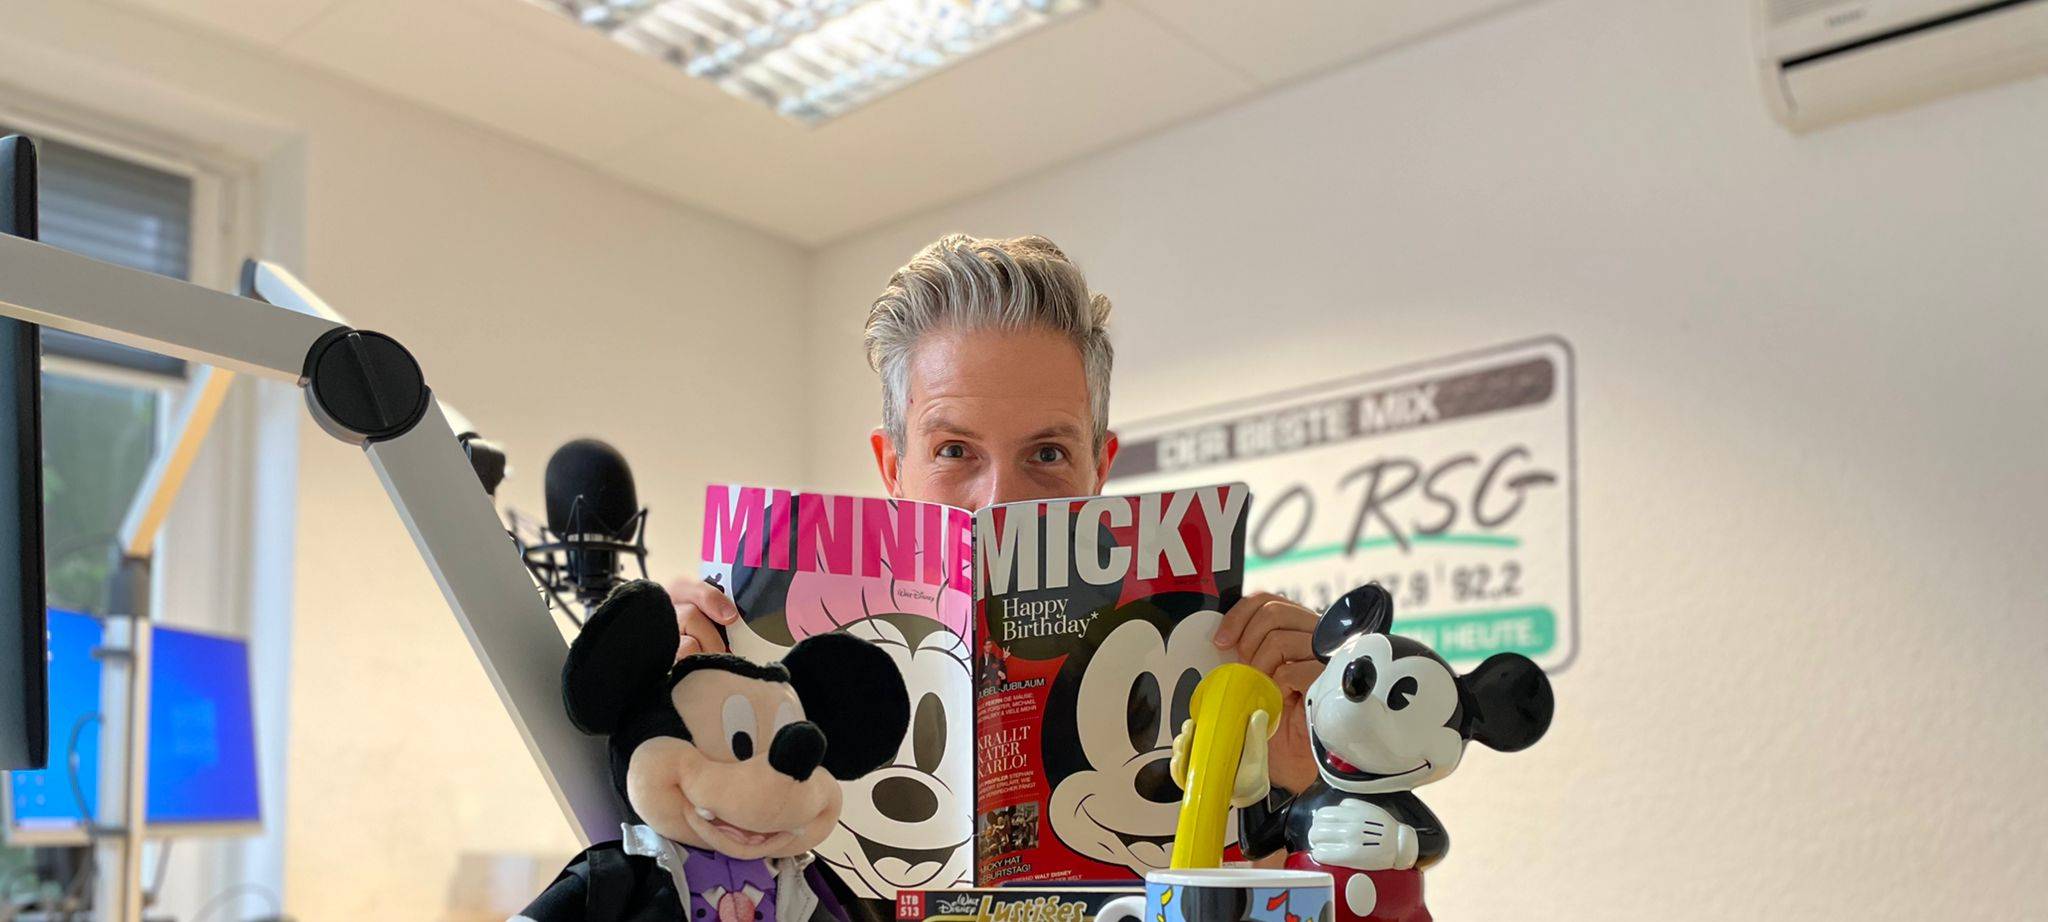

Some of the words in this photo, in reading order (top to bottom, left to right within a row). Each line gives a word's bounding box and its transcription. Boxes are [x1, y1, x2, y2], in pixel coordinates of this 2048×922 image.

[1156, 426, 1228, 470] DER
[1233, 401, 1348, 458] BESTE
[1358, 383, 1440, 434] MIX
[1339, 445, 1557, 558] RSG
[702, 485, 972, 597] MINNIE
[976, 483, 1248, 601] MICKY
[1002, 597, 1069, 622] Happy
[1004, 855, 1021, 866] HAT
[981, 864, 1031, 883] EBURTSTAG!
[1034, 872, 1050, 881] WALT
[1050, 869, 1073, 878] DISNEY
[900, 894, 919, 906] LTB
[935, 899, 977, 916] Disney
[900, 905, 920, 917] 513
